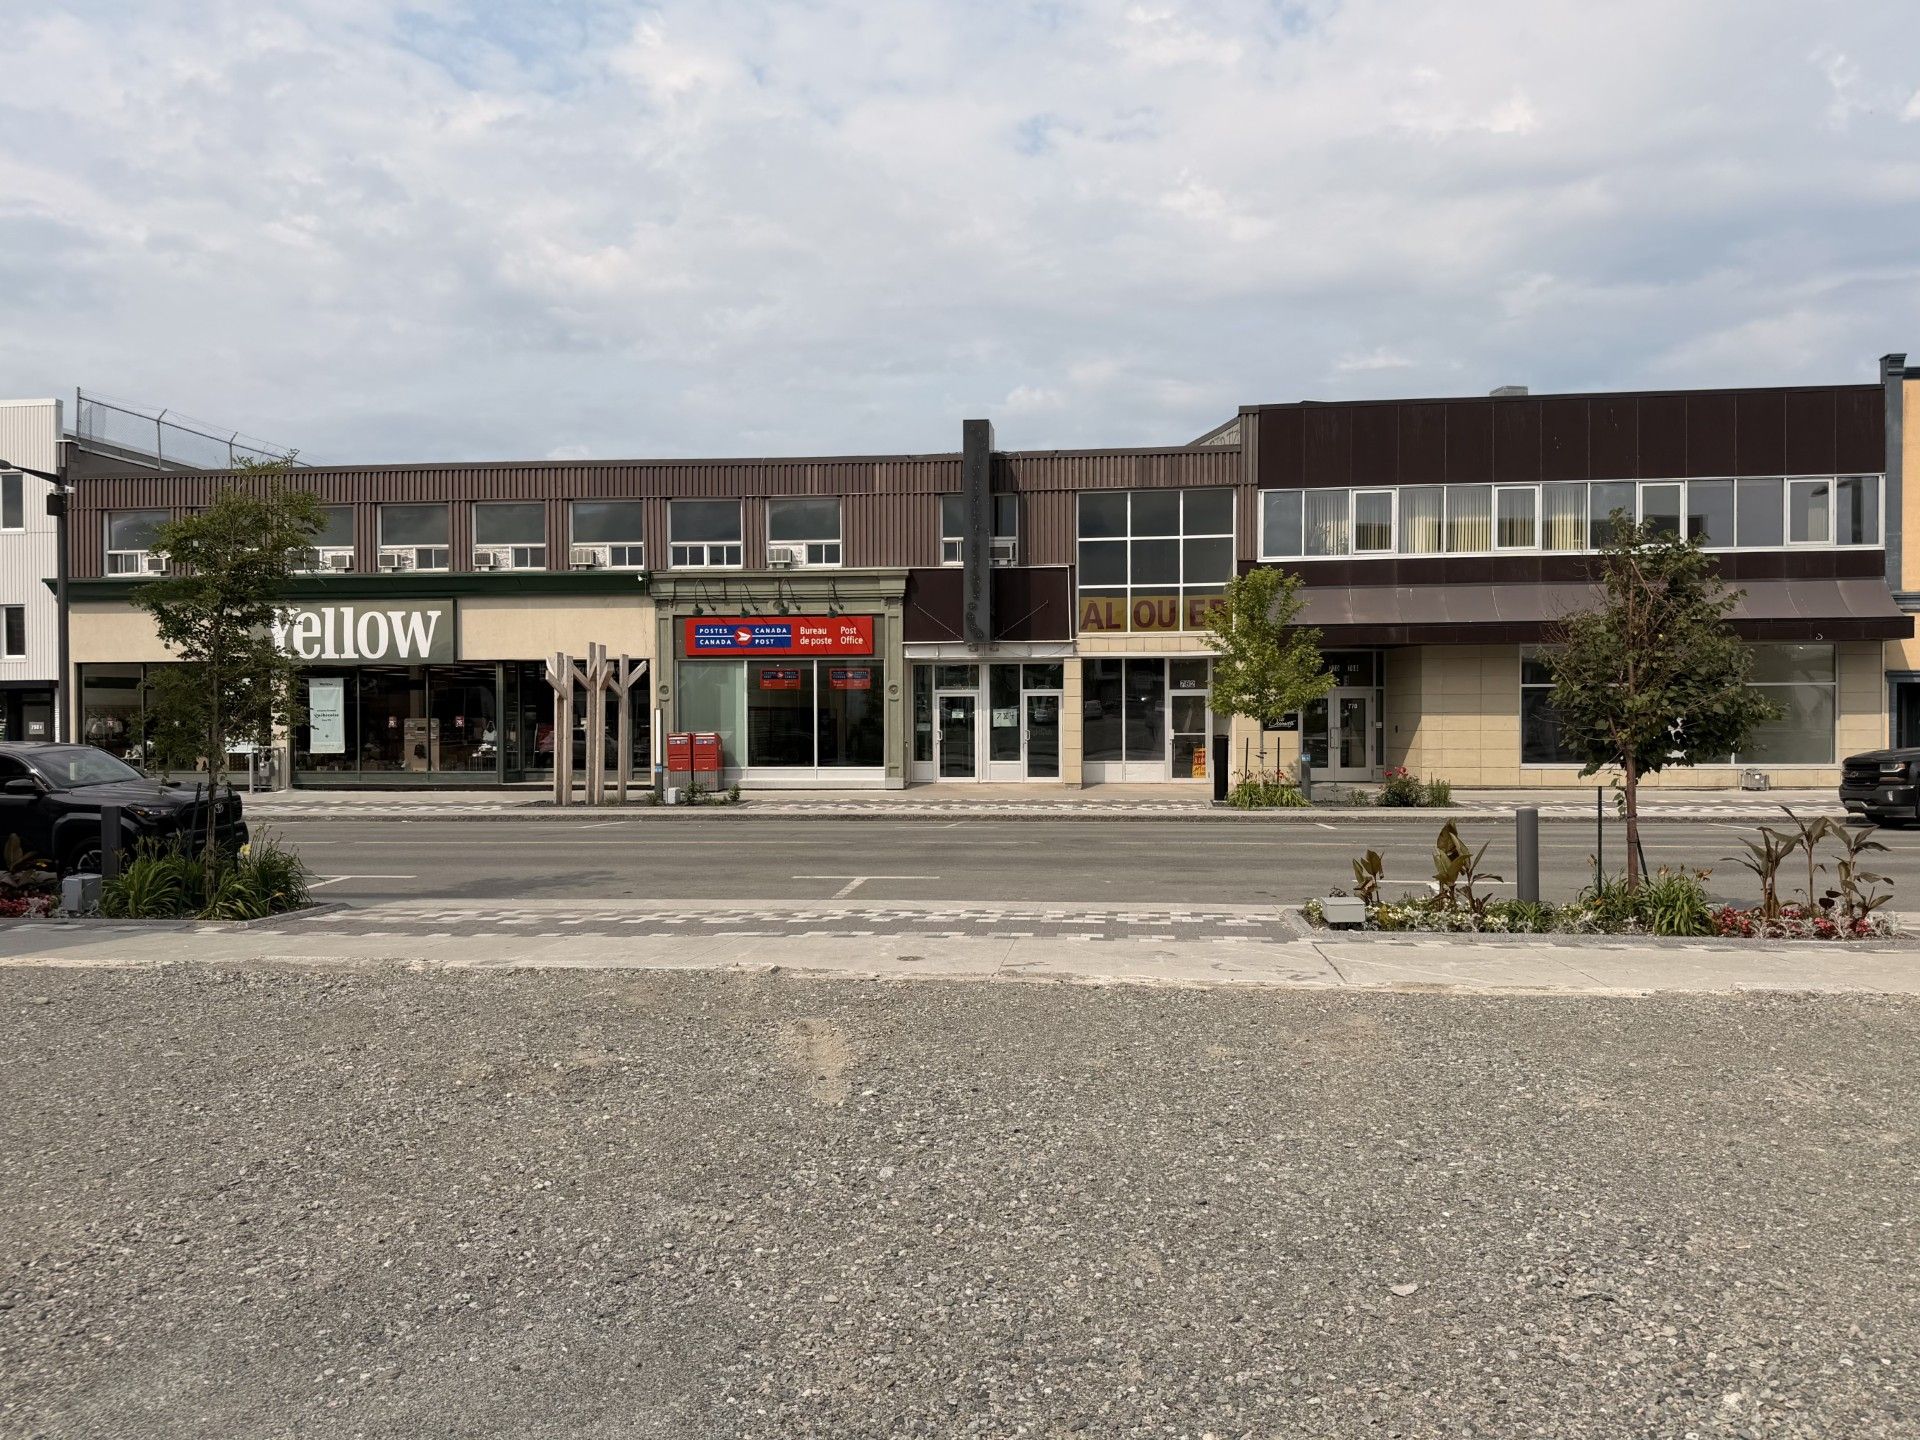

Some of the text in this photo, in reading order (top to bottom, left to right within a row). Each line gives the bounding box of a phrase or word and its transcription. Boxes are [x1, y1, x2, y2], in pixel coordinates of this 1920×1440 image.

[270, 607, 442, 660] Yellow
[800, 627, 827, 635] Bureau
[841, 626, 857, 635] Post
[800, 636, 832, 646] de poste
[840, 636, 863, 645] Office
